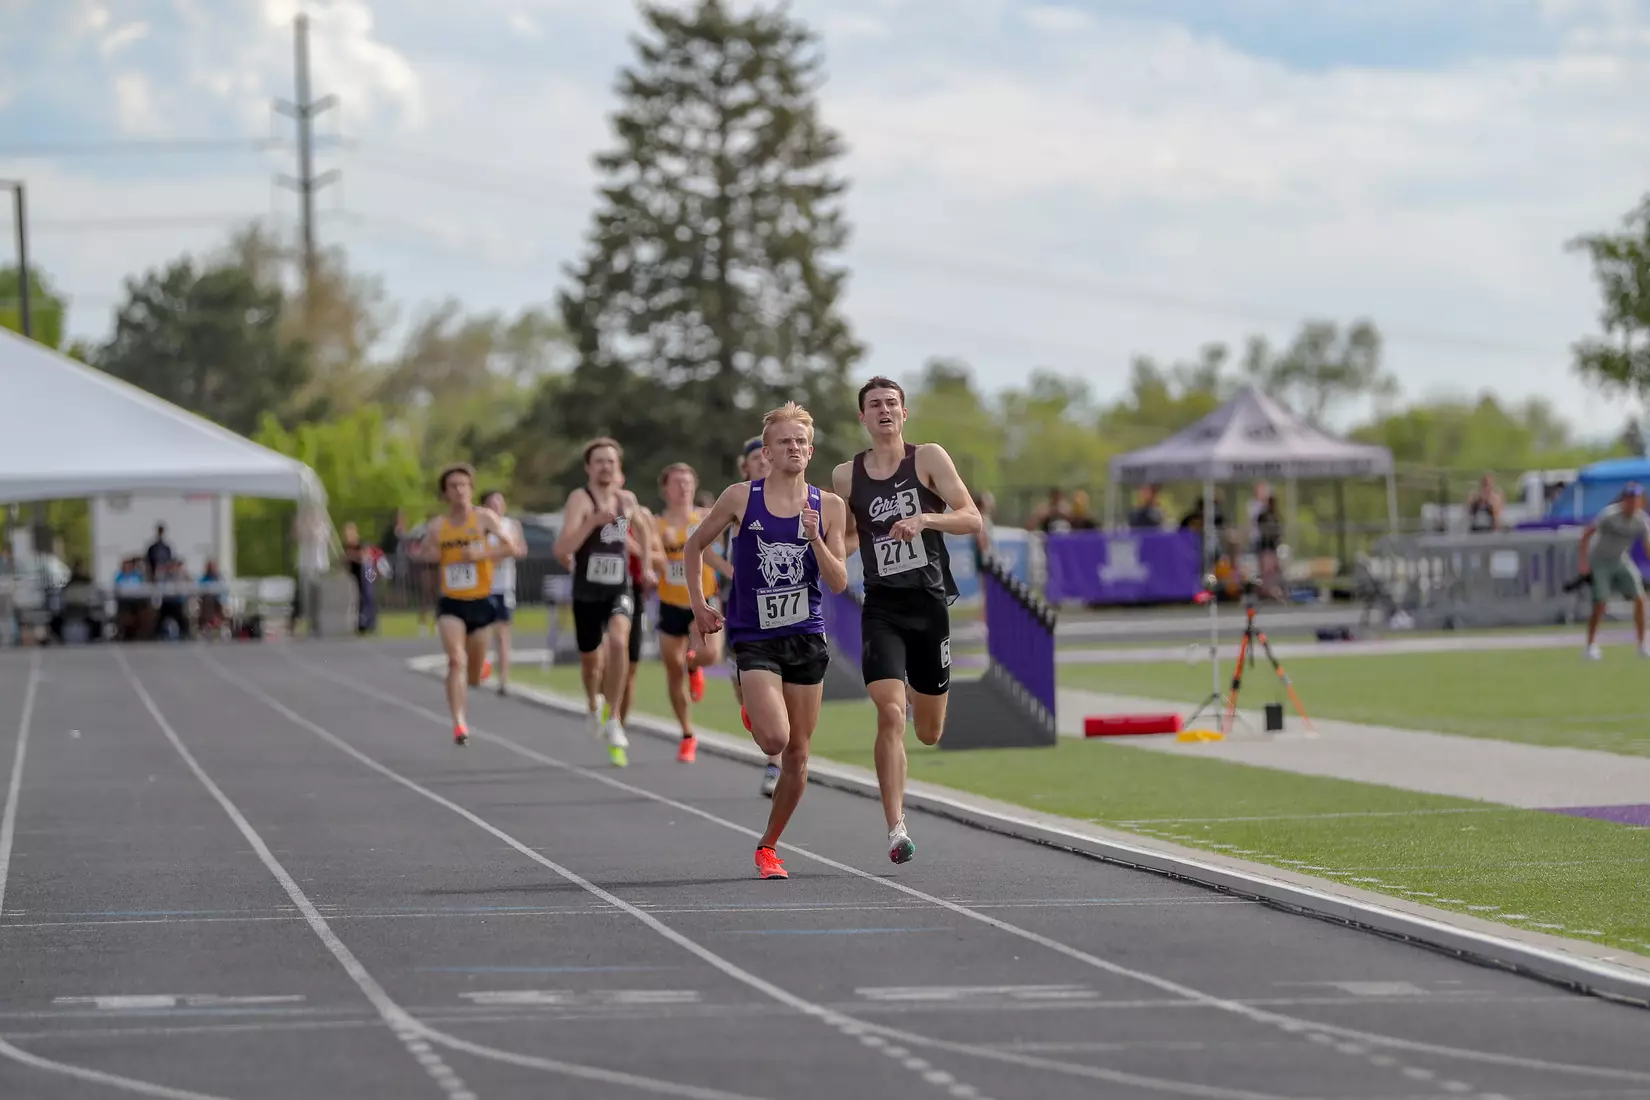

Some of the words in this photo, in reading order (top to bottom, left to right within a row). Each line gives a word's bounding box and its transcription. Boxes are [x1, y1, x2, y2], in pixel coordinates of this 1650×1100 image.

[902, 492, 917, 516] 3
[881, 541, 918, 565] 271
[765, 592, 800, 619] 577
